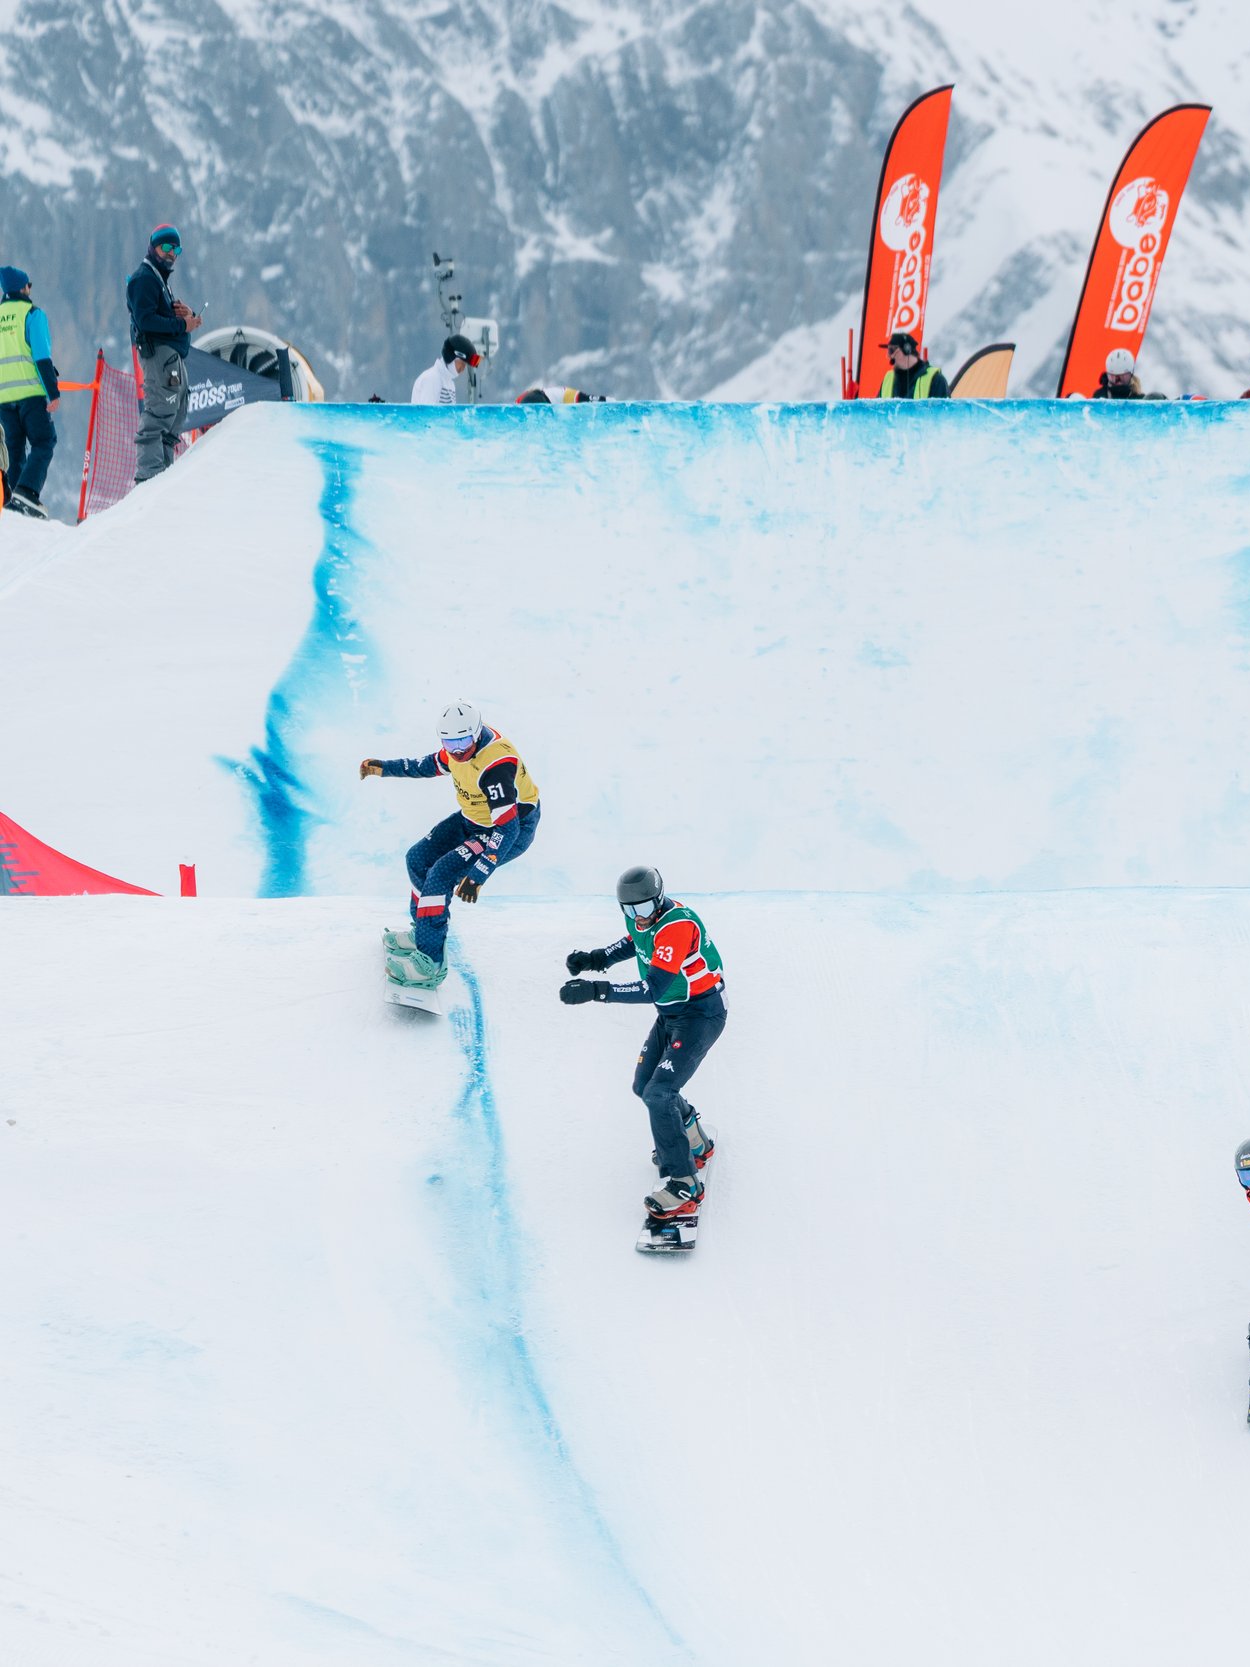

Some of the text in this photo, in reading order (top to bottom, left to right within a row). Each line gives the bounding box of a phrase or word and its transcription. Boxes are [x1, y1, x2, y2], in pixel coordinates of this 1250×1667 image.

[894, 230, 922, 329] babe
[1116, 232, 1157, 325] babe
[0, 313, 16, 322] AFF
[188, 384, 227, 412] ROSS
[227, 382, 243, 393] TOUR
[487, 782, 506, 800] 51
[455, 845, 473, 862] USA
[612, 985, 640, 993] TEZENIS
